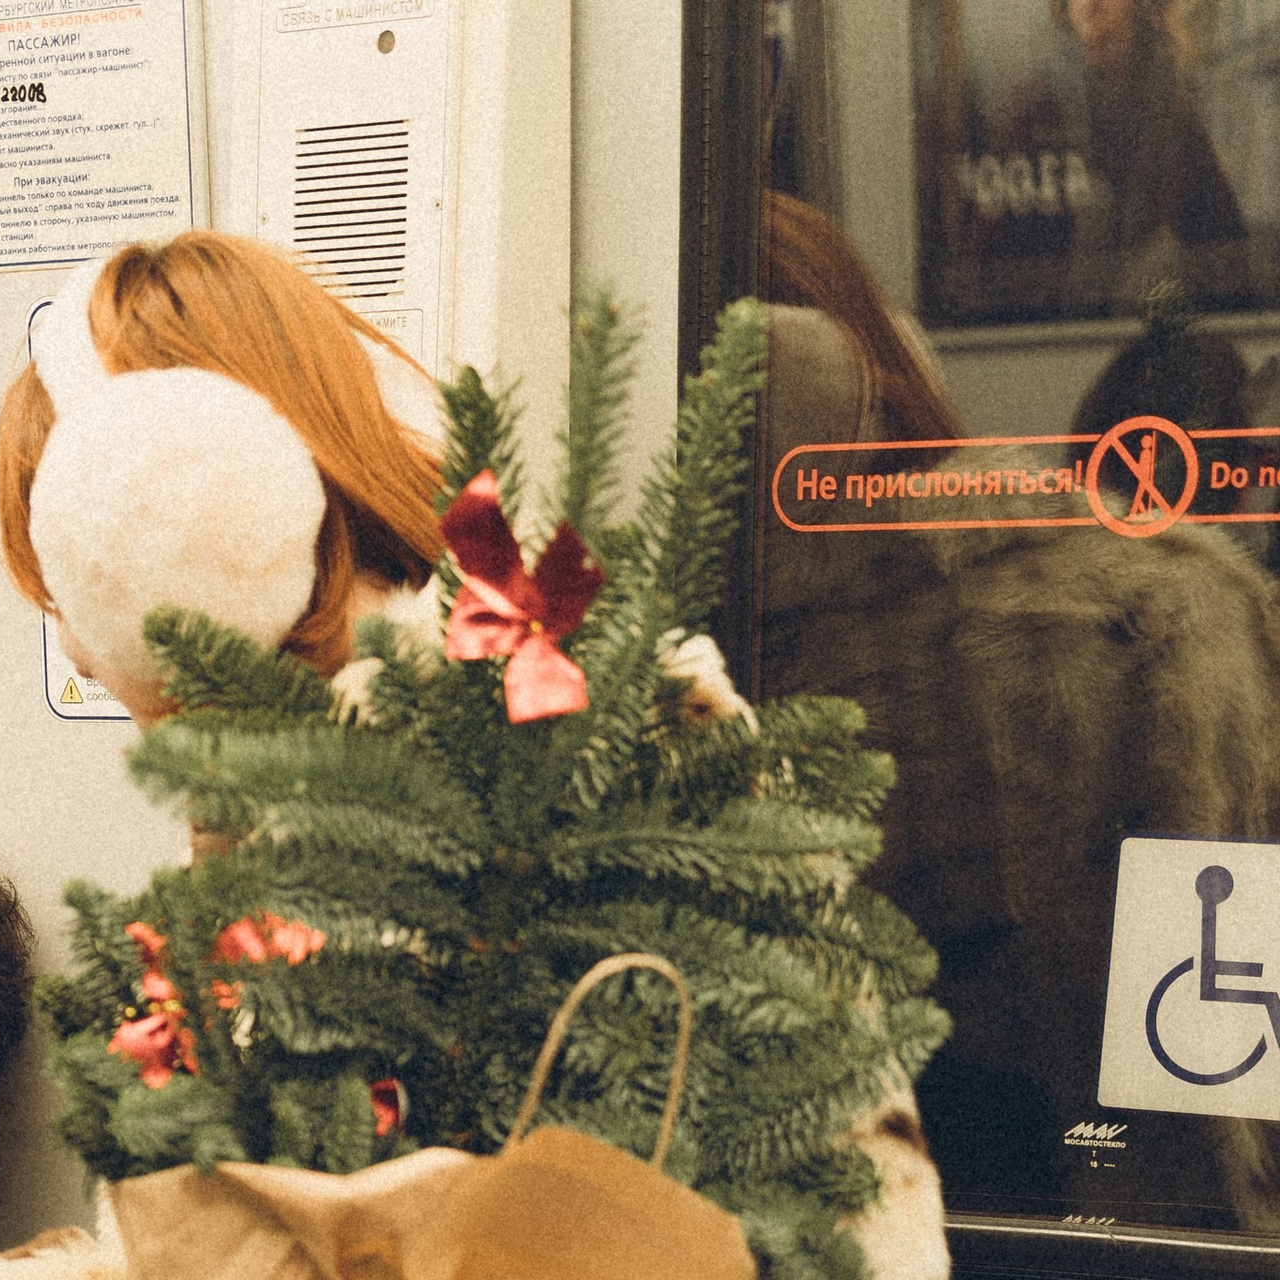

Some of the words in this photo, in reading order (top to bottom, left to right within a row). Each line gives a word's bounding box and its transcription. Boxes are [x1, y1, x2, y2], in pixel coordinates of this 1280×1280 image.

[41, 7, 142, 28] БЕЗОПАСНОСТИ
[283, 11, 320, 27] СВЯЗЬ
[325, 9, 332, 22] С
[8, 33, 80, 52] ПАССАЖИР!
[39, 49, 85, 65] ситуации
[88, 50, 94, 59] в
[97, 46, 133, 58] вагоне:
[18, 73, 28, 81] по
[30, 70, 52, 80] связи
[52, 127, 69, 138] звук
[18, 156, 62, 170] указаниям
[14, 176, 33, 189] При
[35, 173, 91, 188] эвакуации:
[27, 191, 55, 201] только
[56, 190, 66, 198] по
[68, 187, 104, 198] команде
[44, 203, 72, 213] справа
[74, 201, 84, 210] по
[86, 199, 105, 210] ходу
[107, 196, 148, 208] движения
[75, 213, 119, 226] указанную
[29, 242, 75, 254] работников
[1211, 461, 1249, 489] Do
[797, 468, 837, 500] Не
[845, 460, 1083, 508] прислоняться!
